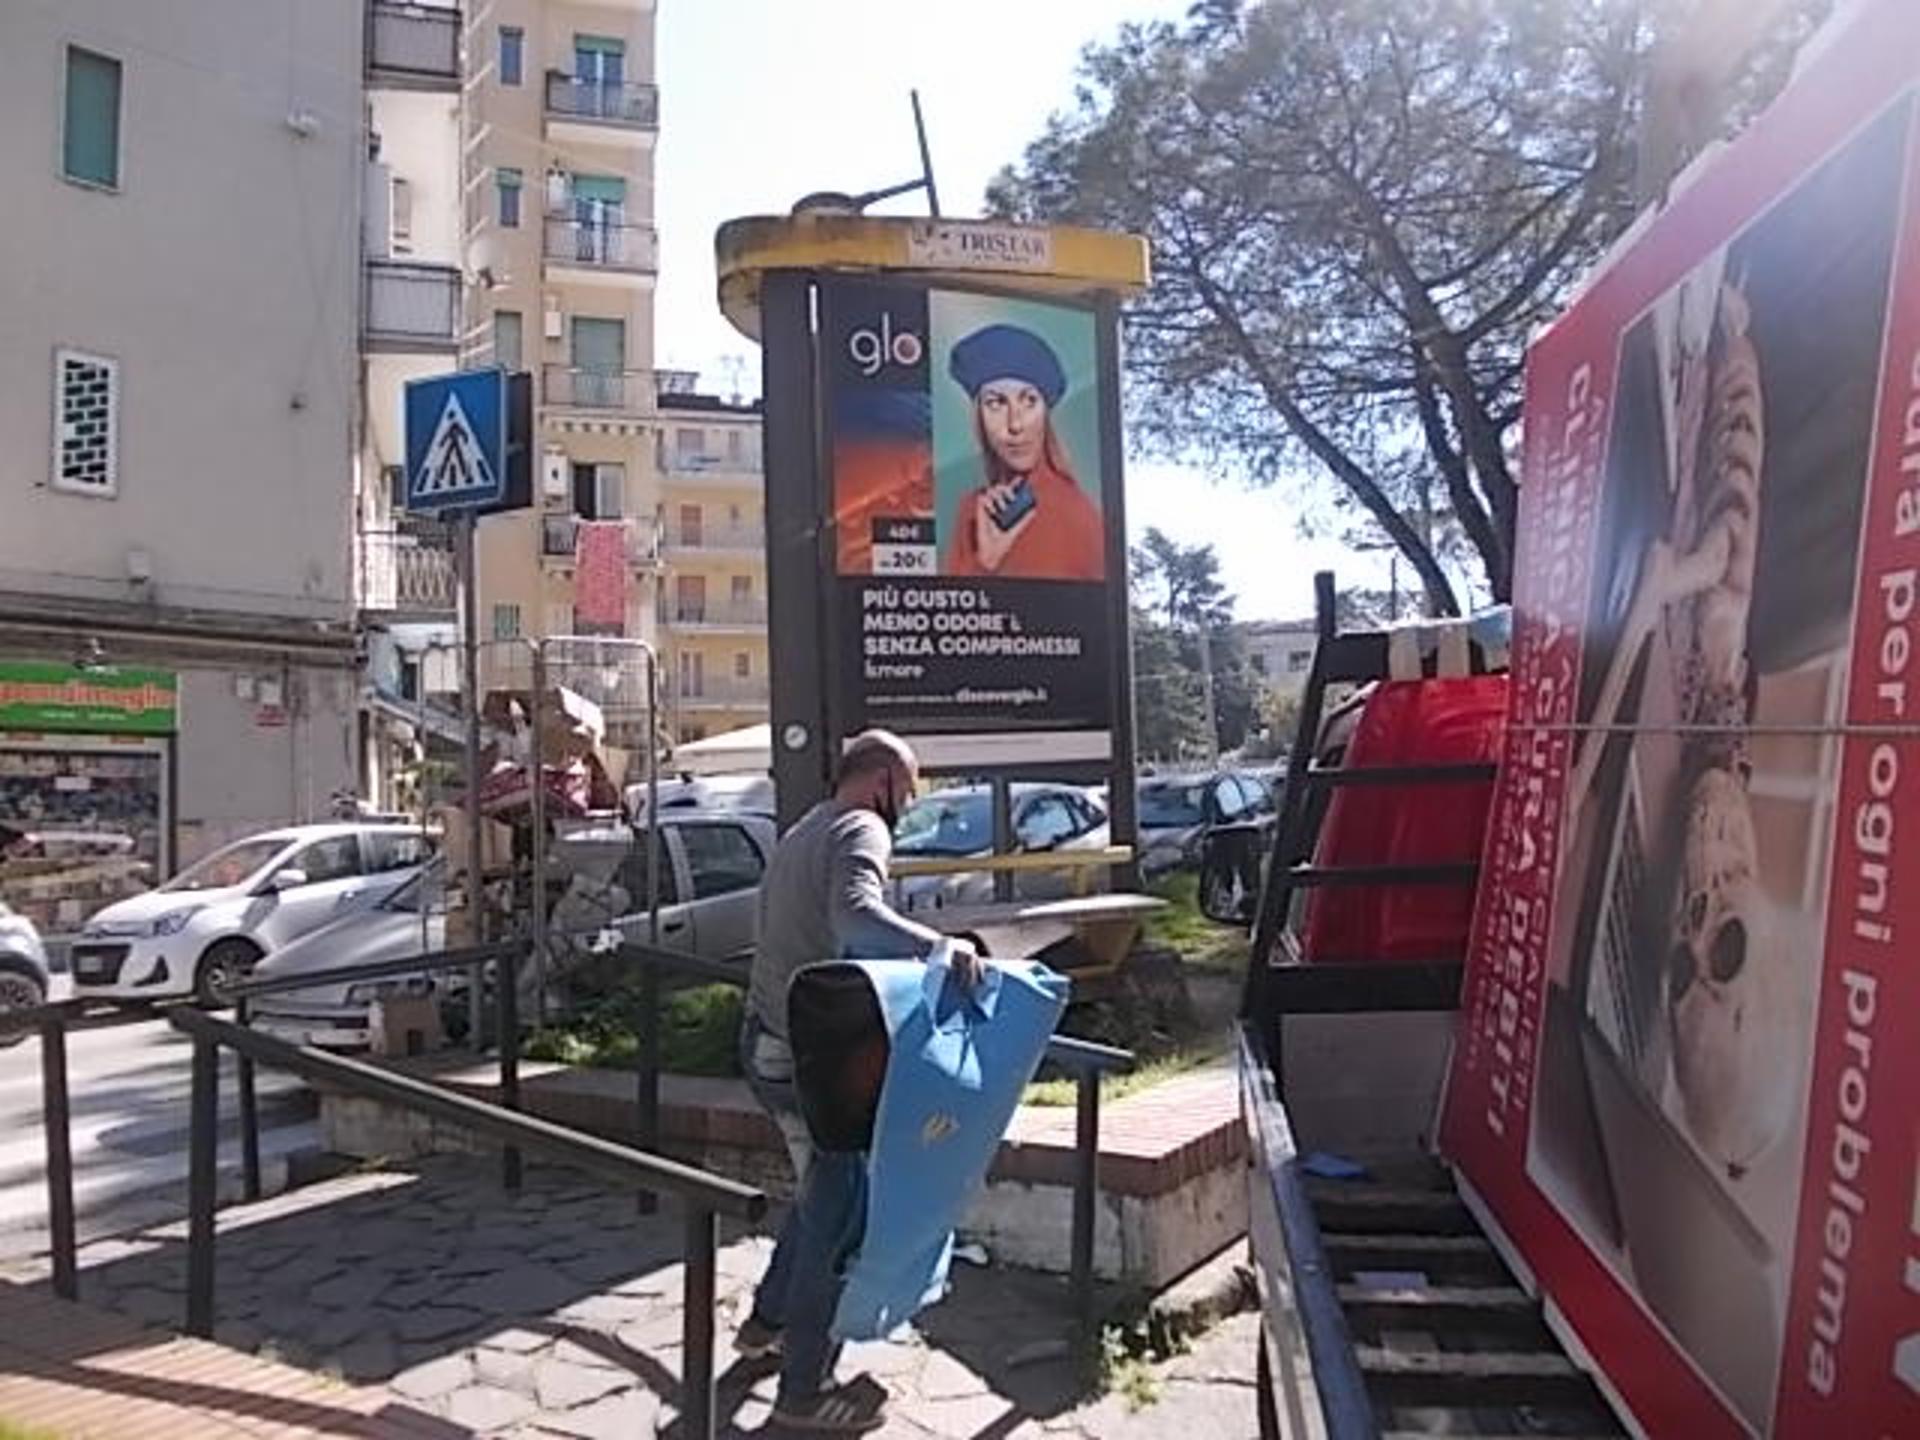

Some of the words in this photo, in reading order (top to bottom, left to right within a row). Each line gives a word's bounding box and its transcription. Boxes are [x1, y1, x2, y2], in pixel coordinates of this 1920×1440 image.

[960, 232, 1046, 258] TRISTAR
[851, 312, 922, 375] glo
[1542, 363, 1591, 651] CLINICA
[863, 585, 899, 609] PIÙ
[902, 590, 976, 608] GUSTO
[863, 613, 930, 632] MENO
[863, 636, 936, 655] SENZA
[938, 637, 1082, 656] COMPROMESSI
[1878, 568, 1917, 715] per
[1518, 677, 1555, 871] CURA
[1855, 743, 1898, 943] ogni
[1486, 897, 1530, 1137] DEBITI
[1512, 798, 1559, 1109] SPECIALISTI
[1808, 968, 1878, 1396] problema
